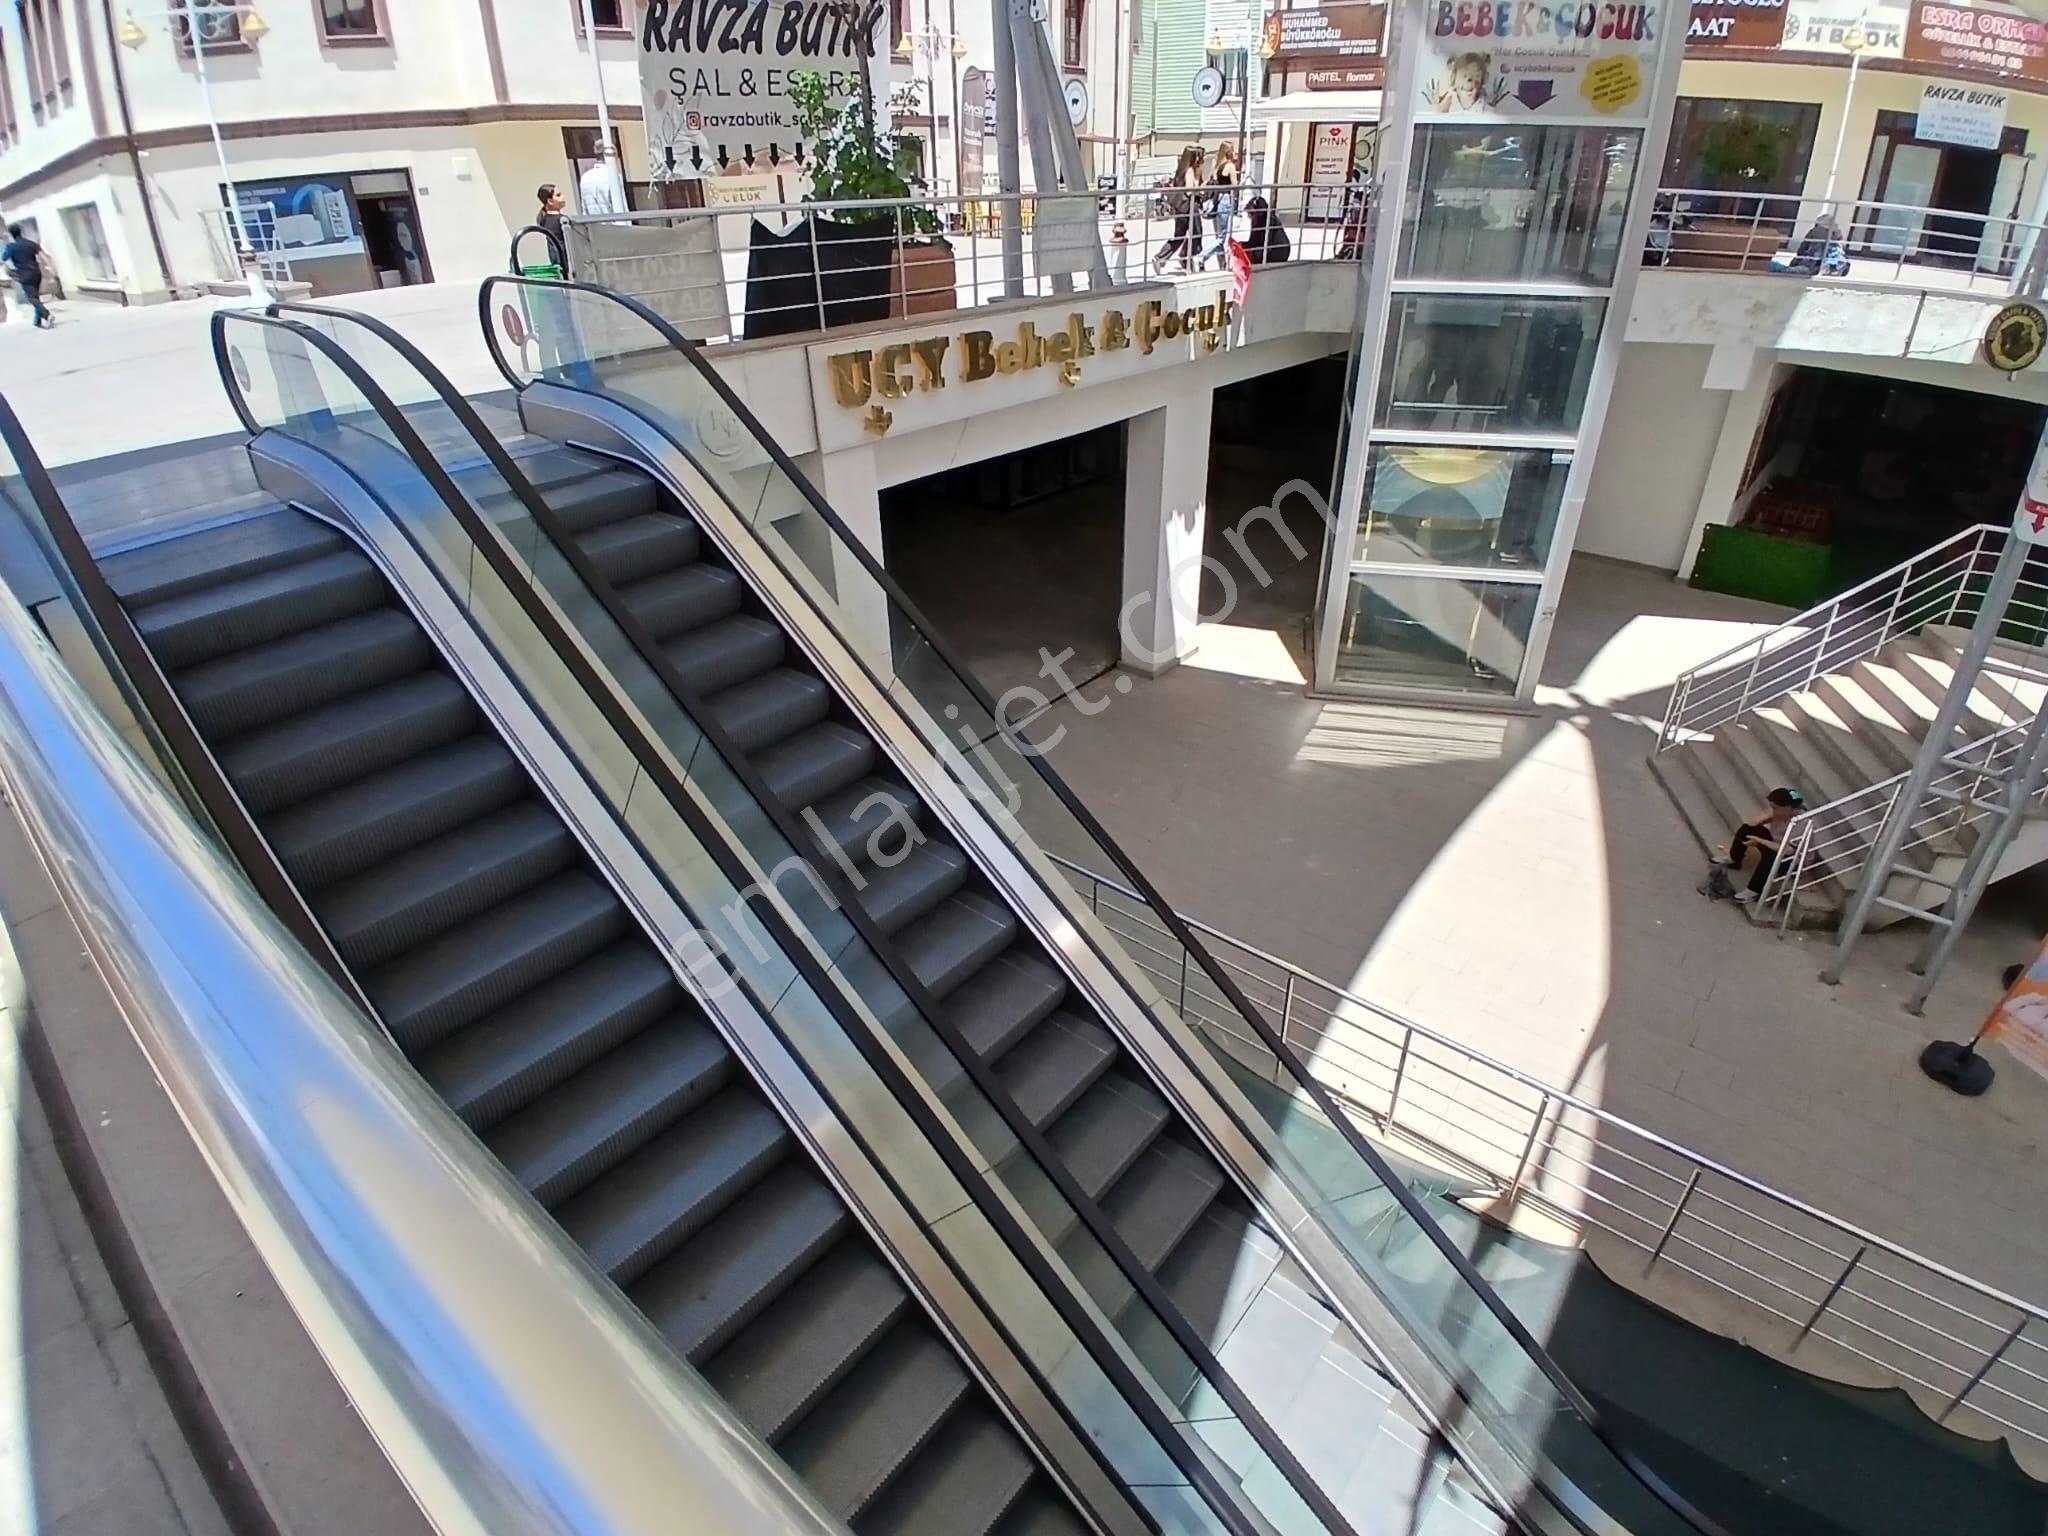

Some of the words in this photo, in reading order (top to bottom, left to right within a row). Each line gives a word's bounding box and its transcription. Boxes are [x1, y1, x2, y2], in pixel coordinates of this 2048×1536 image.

[643, 0, 770, 53] RAVZA
[1435, 0, 1534, 38] BEBEK
[1554, 2, 1655, 45] ÇOCUK
[1921, 6, 1974, 30] ESRA
[1806, 26, 1822, 42] H
[1829, 28, 1899, 48] BOK
[669, 67, 731, 104] ŞAL
[738, 67, 757, 98] &
[1308, 71, 1342, 83] PASTEL
[1924, 85, 1965, 103] RAVZA
[1319, 137, 1349, 147] PINK
[1099, 309, 1131, 351] &
